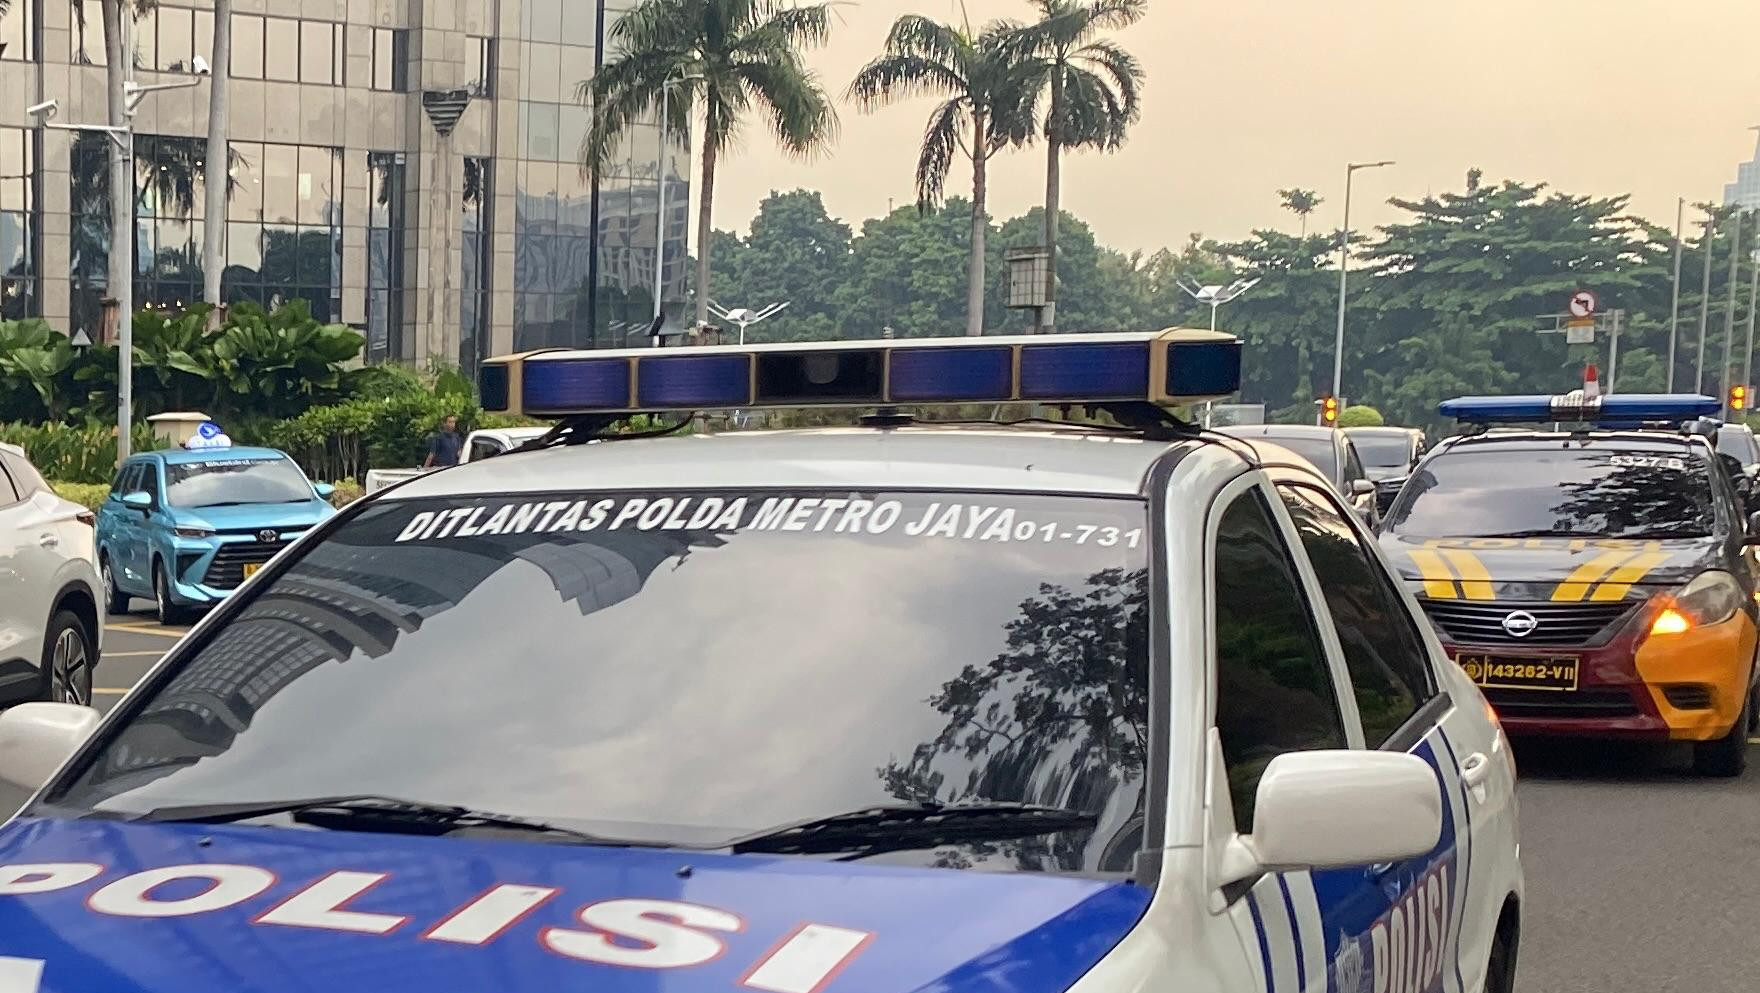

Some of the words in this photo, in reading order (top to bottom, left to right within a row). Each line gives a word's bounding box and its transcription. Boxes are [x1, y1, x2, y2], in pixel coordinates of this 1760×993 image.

[395, 499, 614, 543] DITLANTAS
[607, 497, 747, 531] POLDA
[746, 498, 903, 534] METRO
[904, 502, 1016, 542] JAYA
[1013, 520, 1143, 548] 01-731
